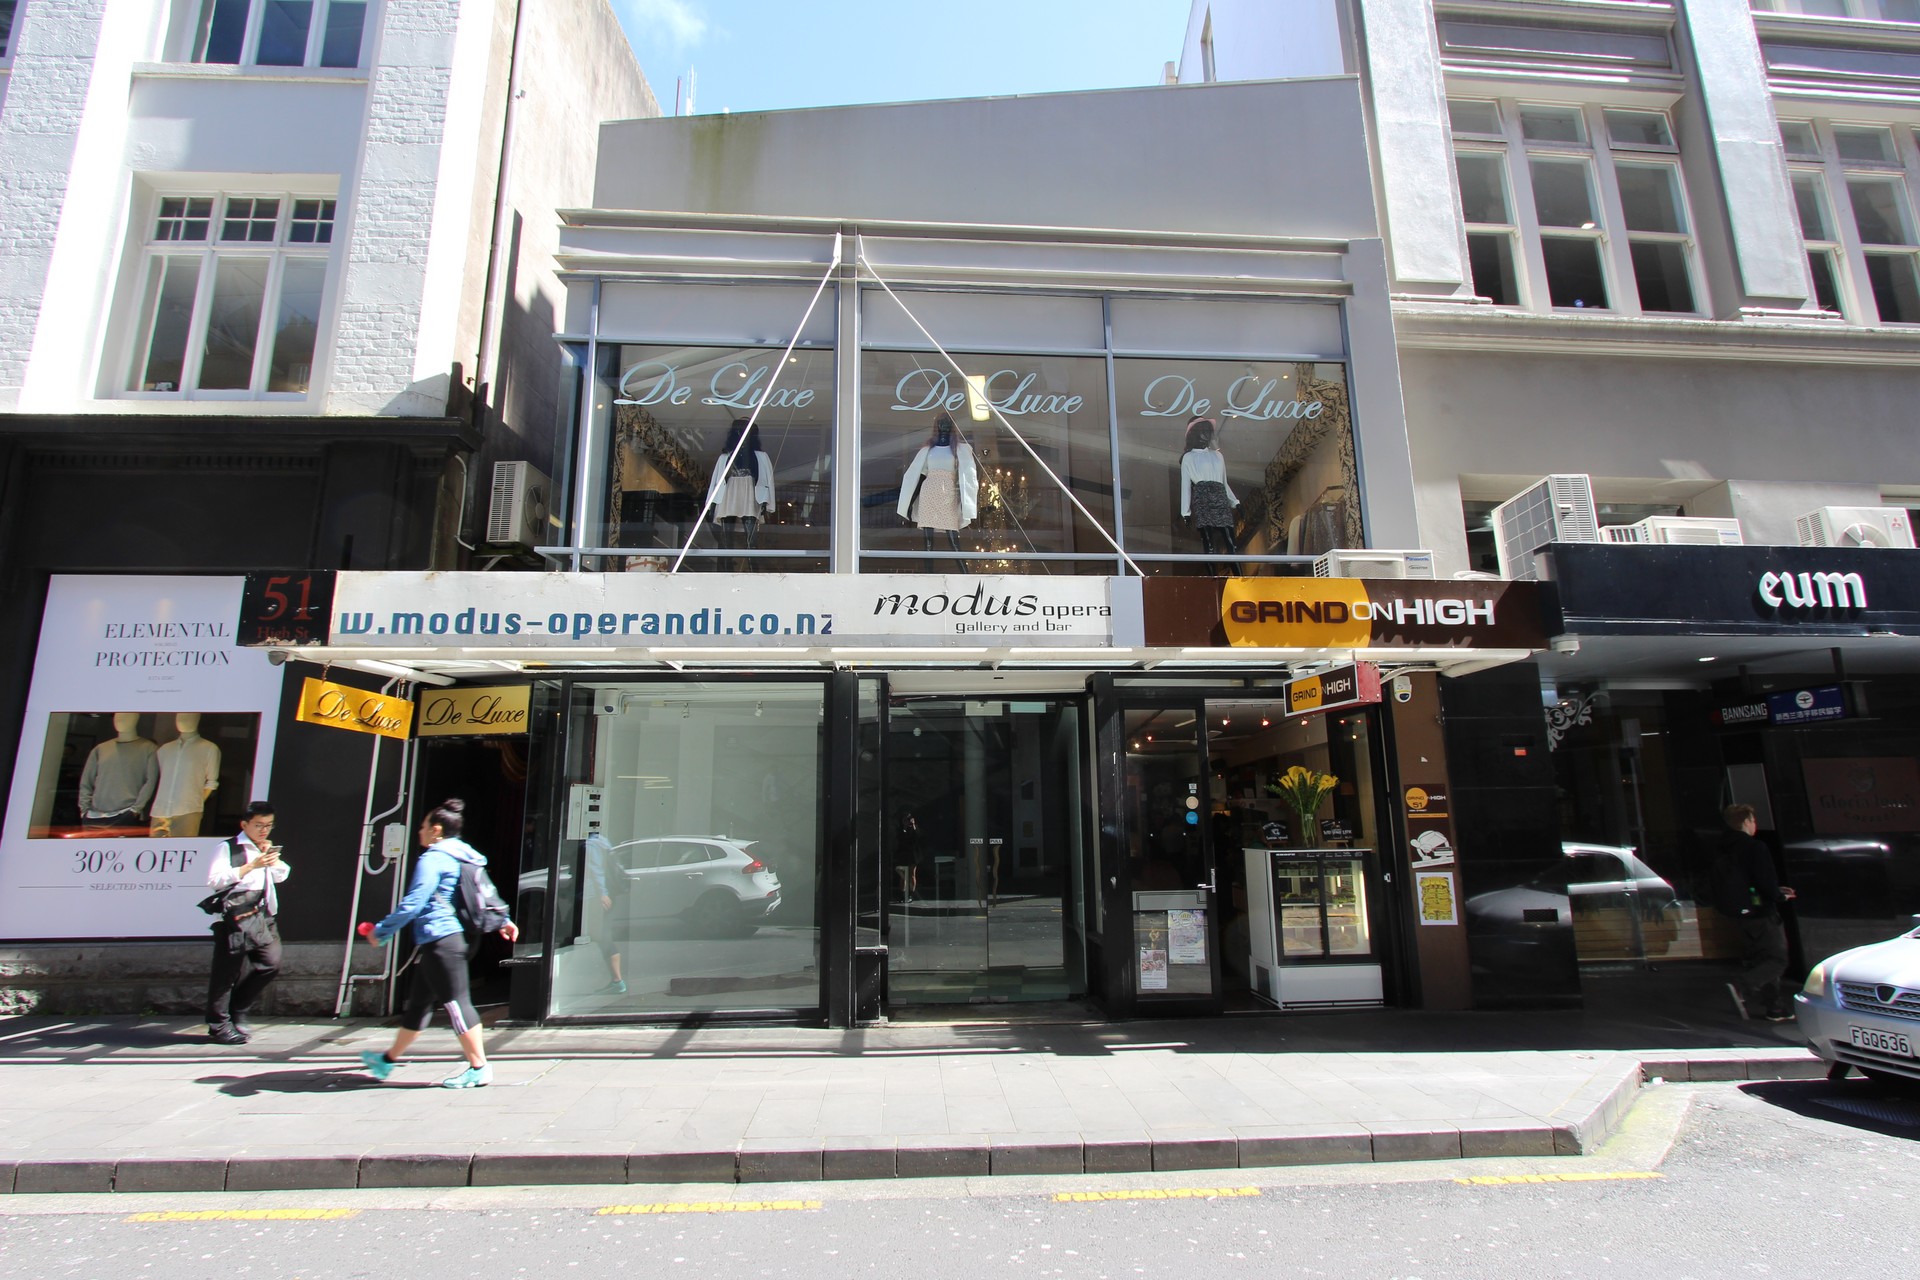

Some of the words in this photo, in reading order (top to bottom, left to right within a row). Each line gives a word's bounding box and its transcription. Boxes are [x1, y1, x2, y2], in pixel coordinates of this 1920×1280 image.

[613, 361, 692, 405] De
[701, 362, 815, 409] Luxe
[890, 368, 966, 411] De
[975, 369, 1083, 416] Luxe
[1140, 374, 1211, 417] De
[1220, 375, 1325, 421] Luxe
[258, 576, 314, 621] 51
[873, 578, 1039, 616] modus
[1042, 604, 1112, 619] opera
[1759, 571, 1868, 608] eum
[339, 607, 832, 640] w.modus-operandi.co.nz
[955, 621, 1007, 634] gallery
[1013, 621, 1040, 632] and
[1045, 618, 1072, 632] bar
[1230, 600, 1349, 624] GRIND
[1351, 601, 1394, 621] ON
[1394, 598, 1496, 626] HIGH
[104, 622, 230, 639] ELEMENTAL
[257, 626, 291, 640] High
[294, 626, 309, 639] St
[95, 650, 232, 667] PROTECTION
[1292, 687, 1317, 702] GRIND
[1326, 677, 1351, 696] HIGH
[313, 689, 351, 721] De
[352, 698, 402, 732] Luxe
[422, 697, 462, 726] De
[466, 695, 525, 725] Luxe
[1722, 702, 1768, 721] BANNSANG
[72, 849, 125, 873] 30%
[135, 849, 198, 873] OFF
[89, 883, 137, 891] SELECTED
[138, 882, 172, 891] STYLES
[1851, 1028, 1909, 1053] FGQ636
